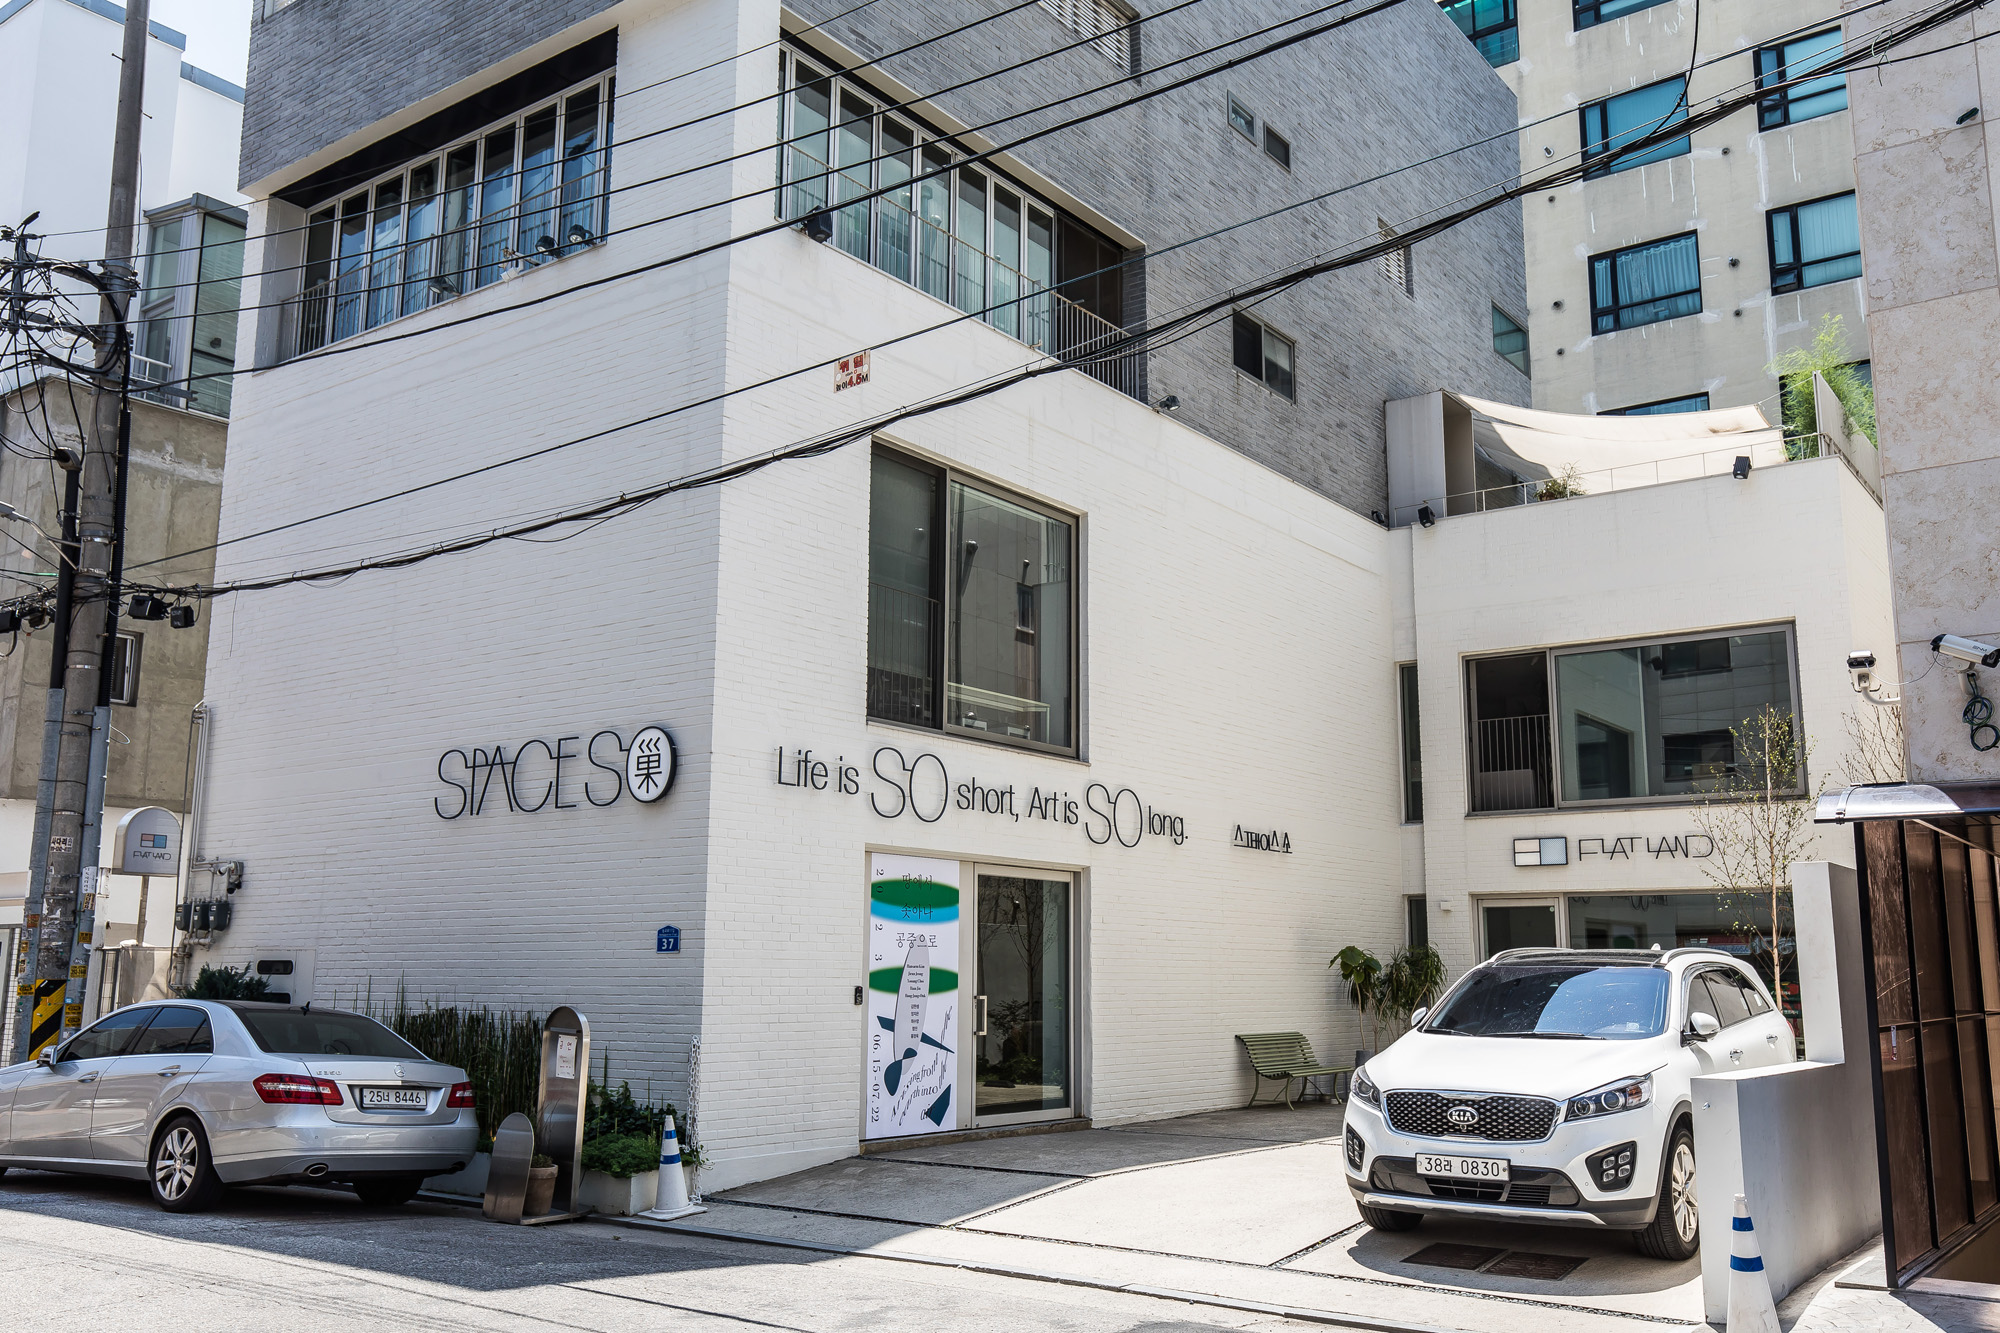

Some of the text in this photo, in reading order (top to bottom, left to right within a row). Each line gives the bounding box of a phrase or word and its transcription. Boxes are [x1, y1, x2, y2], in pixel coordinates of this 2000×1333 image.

[778, 746, 1188, 847] Life is SO short, Art is SO long.
[902, 873, 933, 890] 땅에서
[901, 904, 933, 919] 솟아나
[661, 938, 674, 950] 37
[896, 932, 938, 948] 공중으로
[394, 1091, 422, 1104] 8446
[1452, 1111, 1473, 1121] KIA
[1424, 1157, 1500, 1177] 38라 0830
